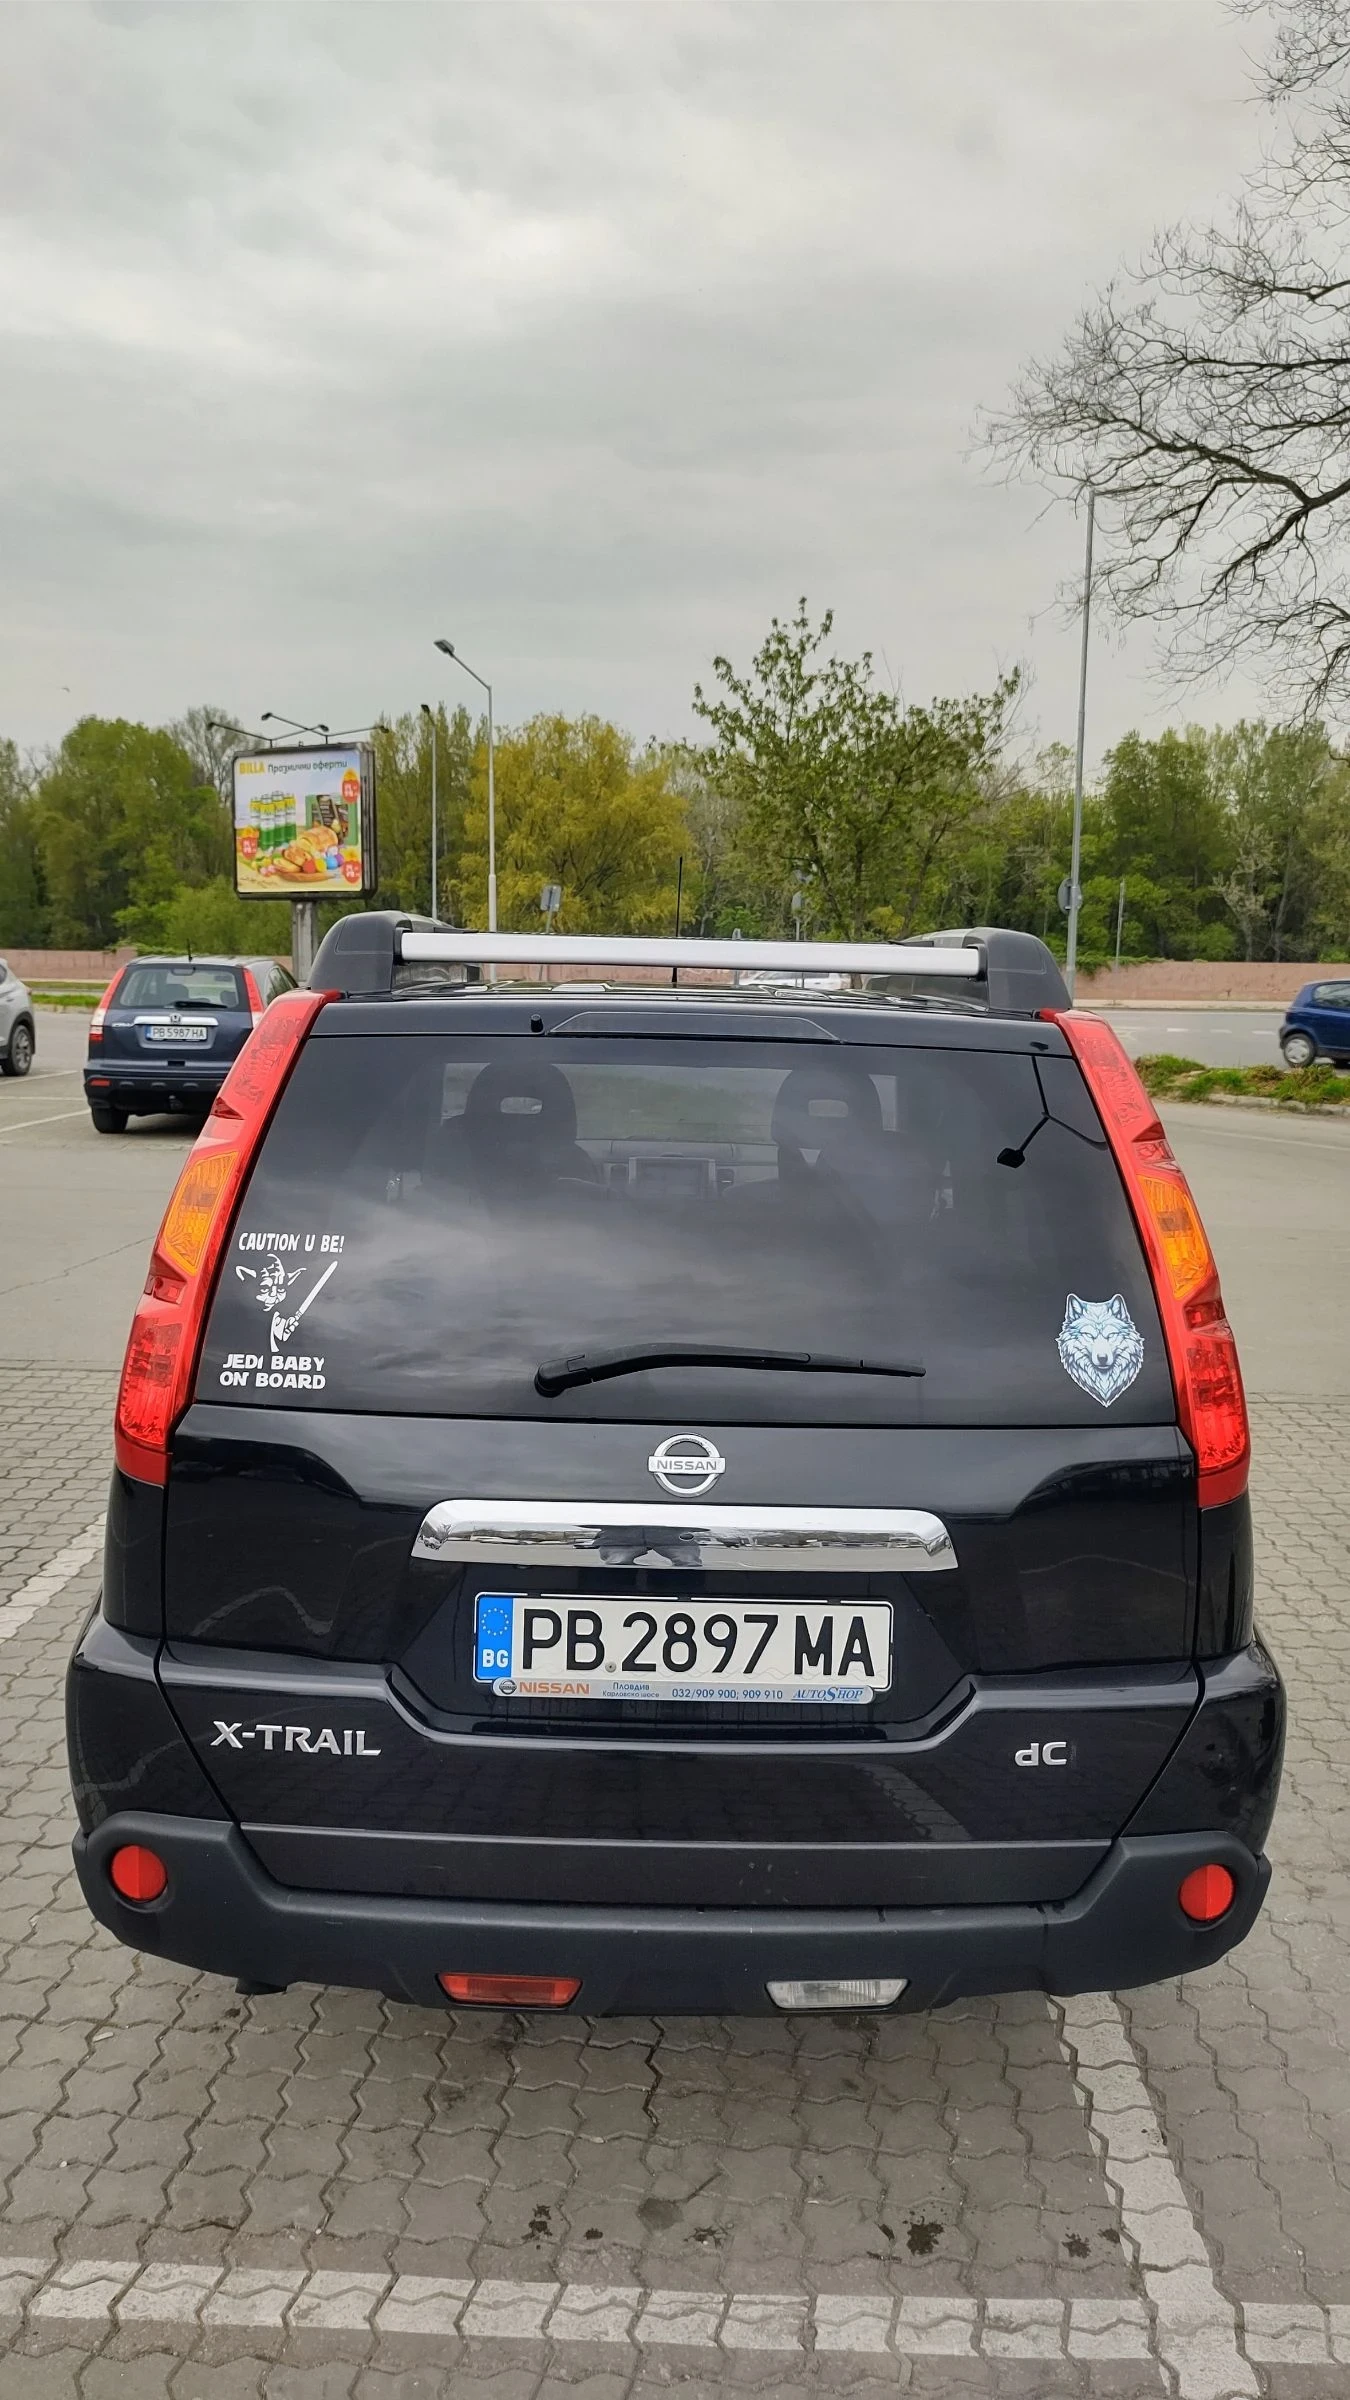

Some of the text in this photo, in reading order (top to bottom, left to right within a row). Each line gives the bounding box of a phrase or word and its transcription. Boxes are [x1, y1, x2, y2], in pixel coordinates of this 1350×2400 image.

[240, 761, 265, 774] BILLA
[312, 760, 348, 771] оферти
[153, 1027, 204, 1038] PB 5987 HA
[238, 1232, 345, 1253] CAUTION U BE!
[222, 1353, 325, 1371] JEDI BABY
[219, 1371, 326, 1389] ON BOARD
[656, 1459, 717, 1471] NISSAN
[522, 1608, 875, 1677] PB 2897 MA
[482, 1648, 509, 1668] BG
[519, 1681, 590, 1695] NISSAN
[612, 1681, 650, 1691] Пловдив
[671, 1688, 715, 1699] 032/909
[742, 1689, 762, 1699] 909
[764, 1690, 783, 1700] 910
[210, 1720, 382, 1756] X-TRAIL
[1014, 1741, 1068, 1767] dC
